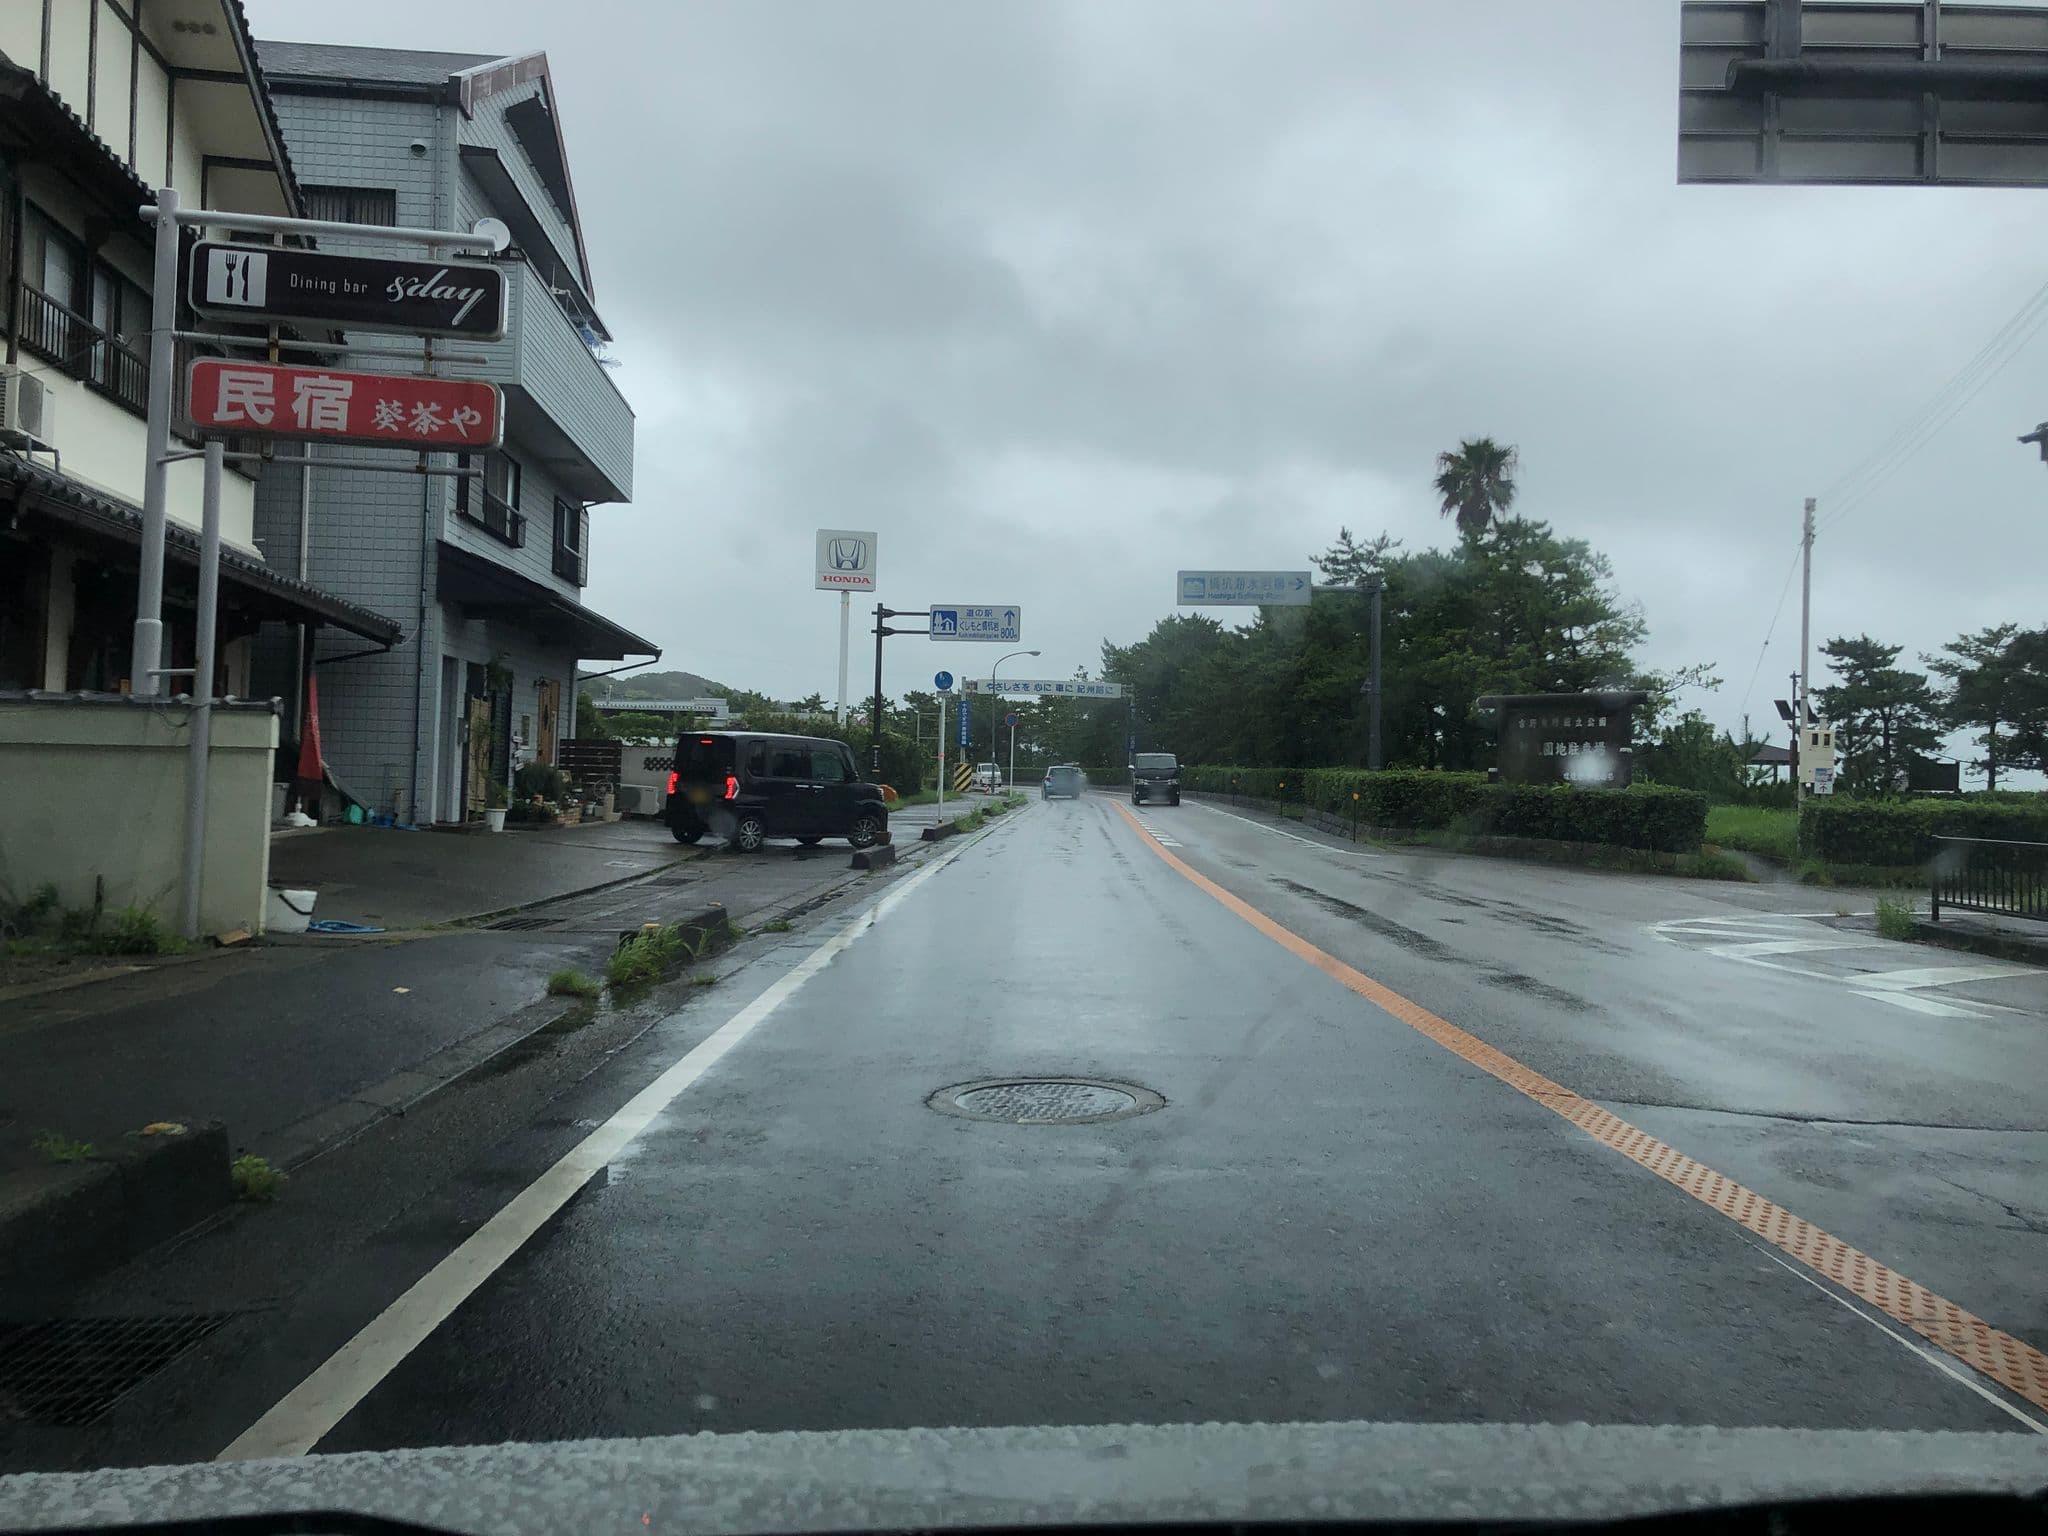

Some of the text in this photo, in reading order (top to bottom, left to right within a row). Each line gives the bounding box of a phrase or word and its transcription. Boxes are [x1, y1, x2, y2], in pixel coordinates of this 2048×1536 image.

[290, 273, 336, 294] Dining
[344, 277, 368, 294] bar
[213, 369, 482, 439] 民宿 葵茶や
[822, 575, 871, 584] HONDA
[966, 608, 993, 617] 道の駅
[986, 682, 1031, 692] やさしさを
[1033, 683, 1051, 692] 心に
[1055, 683, 1073, 693] 車に
